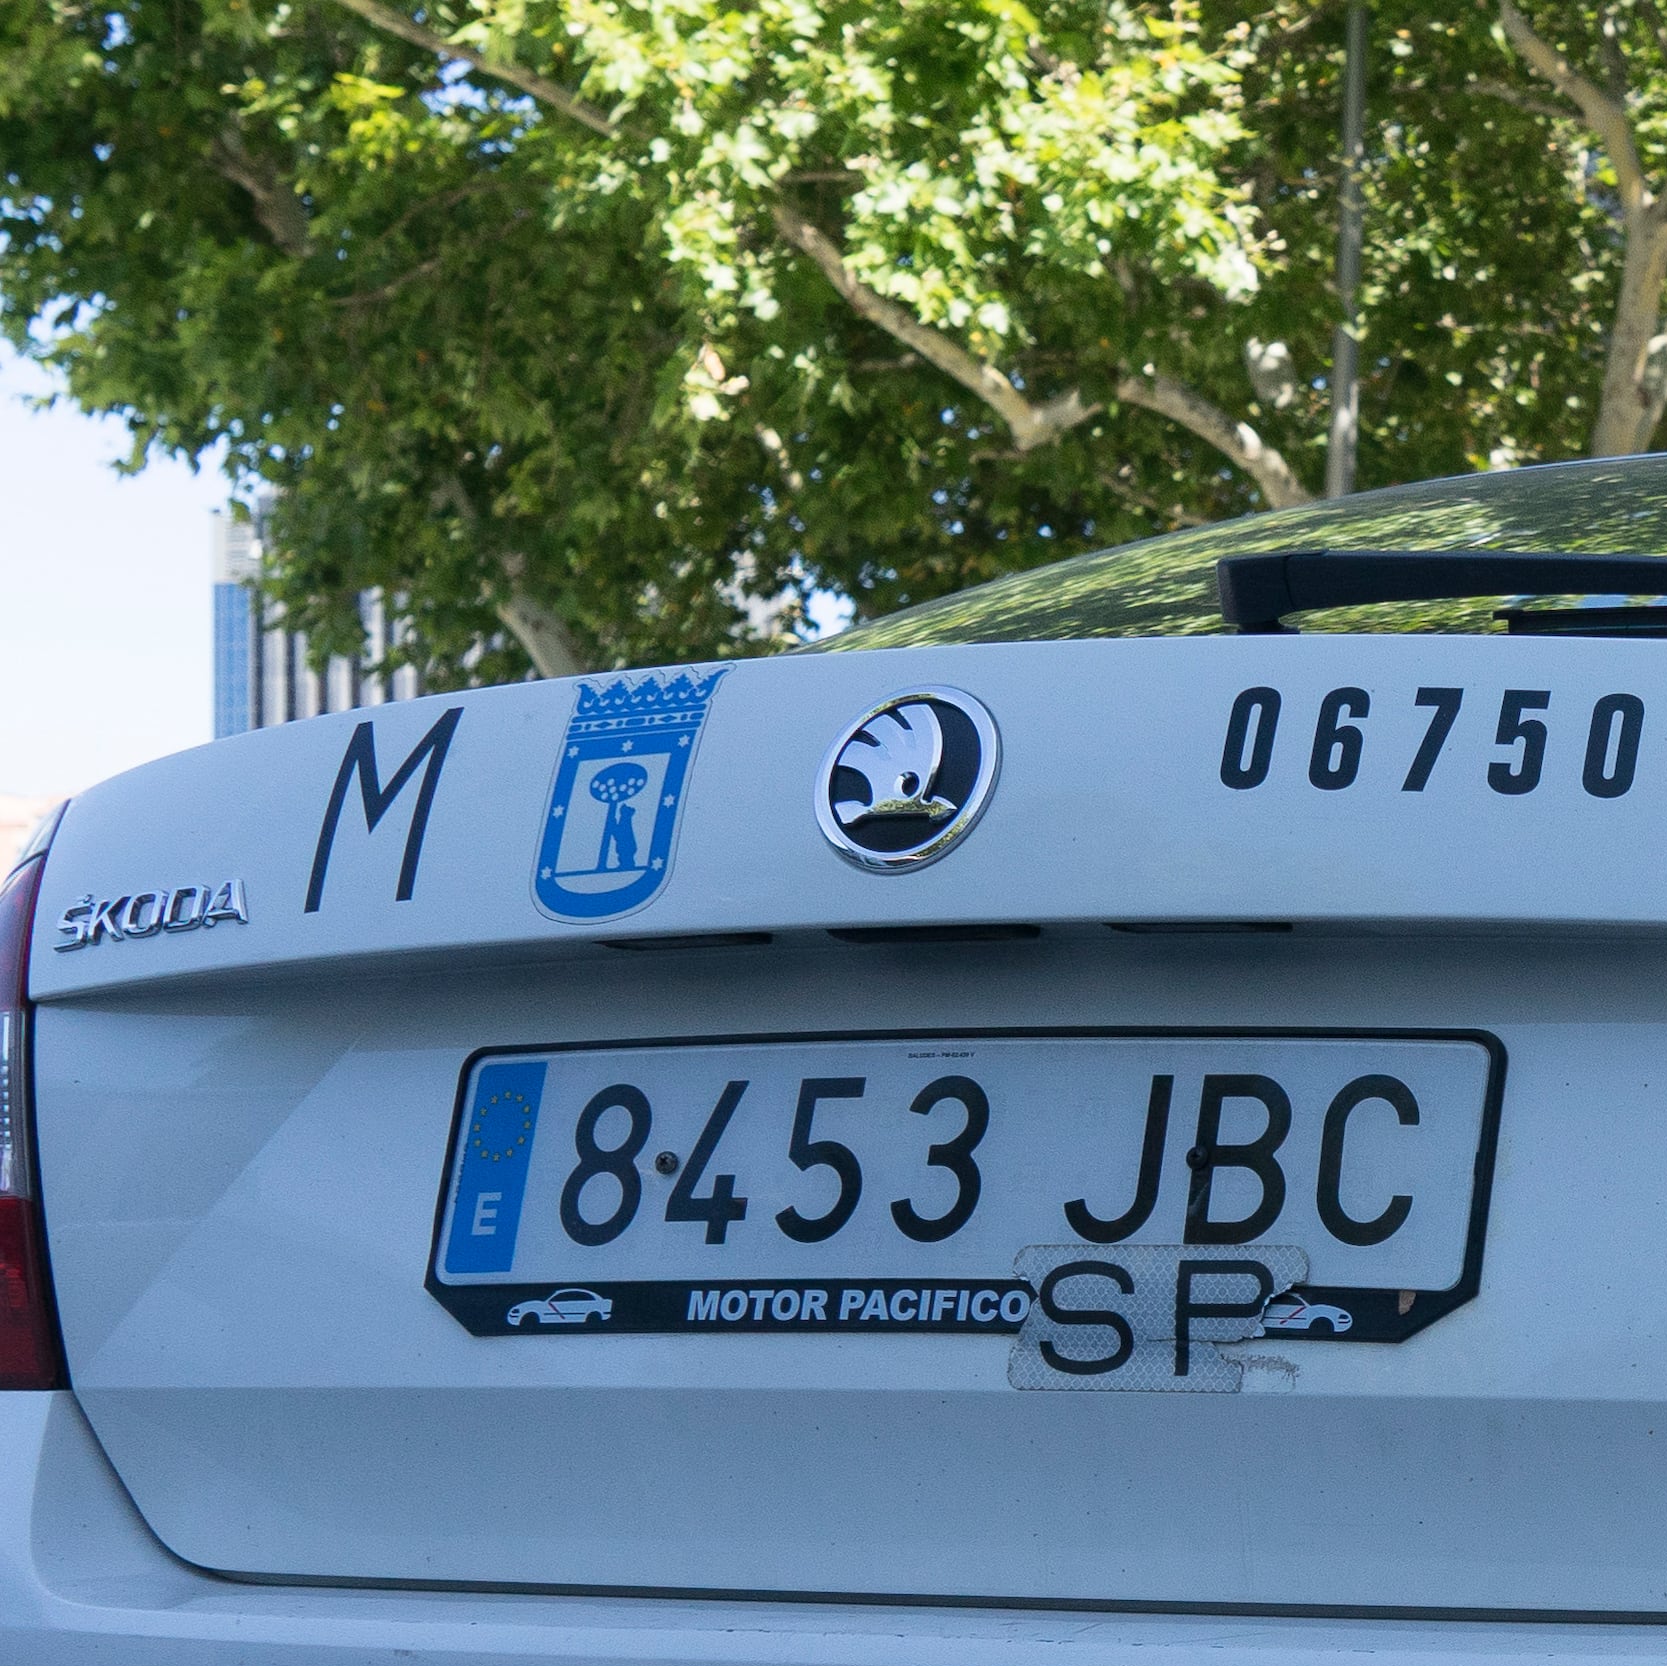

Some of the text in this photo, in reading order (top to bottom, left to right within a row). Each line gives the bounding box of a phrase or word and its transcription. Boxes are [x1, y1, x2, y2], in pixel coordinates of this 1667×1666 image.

[1220, 686, 1645, 799] 06750
[304, 706, 464, 914] M
[54, 878, 248, 953] ŠKODA
[472, 1192, 502, 1236] E
[559, 1073, 1420, 1247] 8453 JBC
[687, 1290, 1030, 1322] MOTOR PACIFICO
[1039, 1260, 1275, 1376] SP
